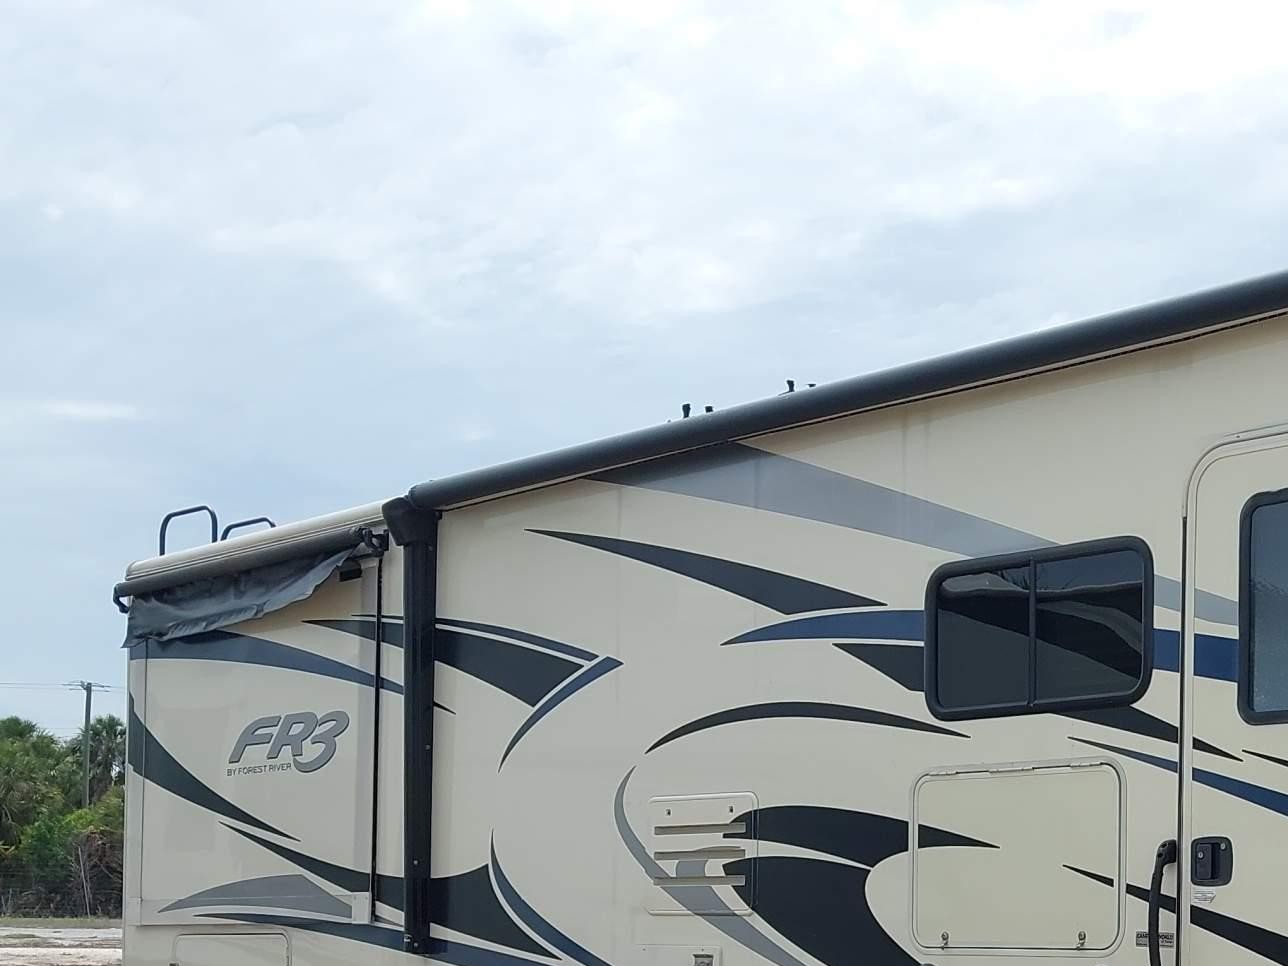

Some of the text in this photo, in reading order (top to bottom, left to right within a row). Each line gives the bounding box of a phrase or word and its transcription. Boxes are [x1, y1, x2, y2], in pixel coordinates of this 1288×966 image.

[228, 710, 350, 774] FR3
[226, 763, 292, 777] BY FOREST RIVER
